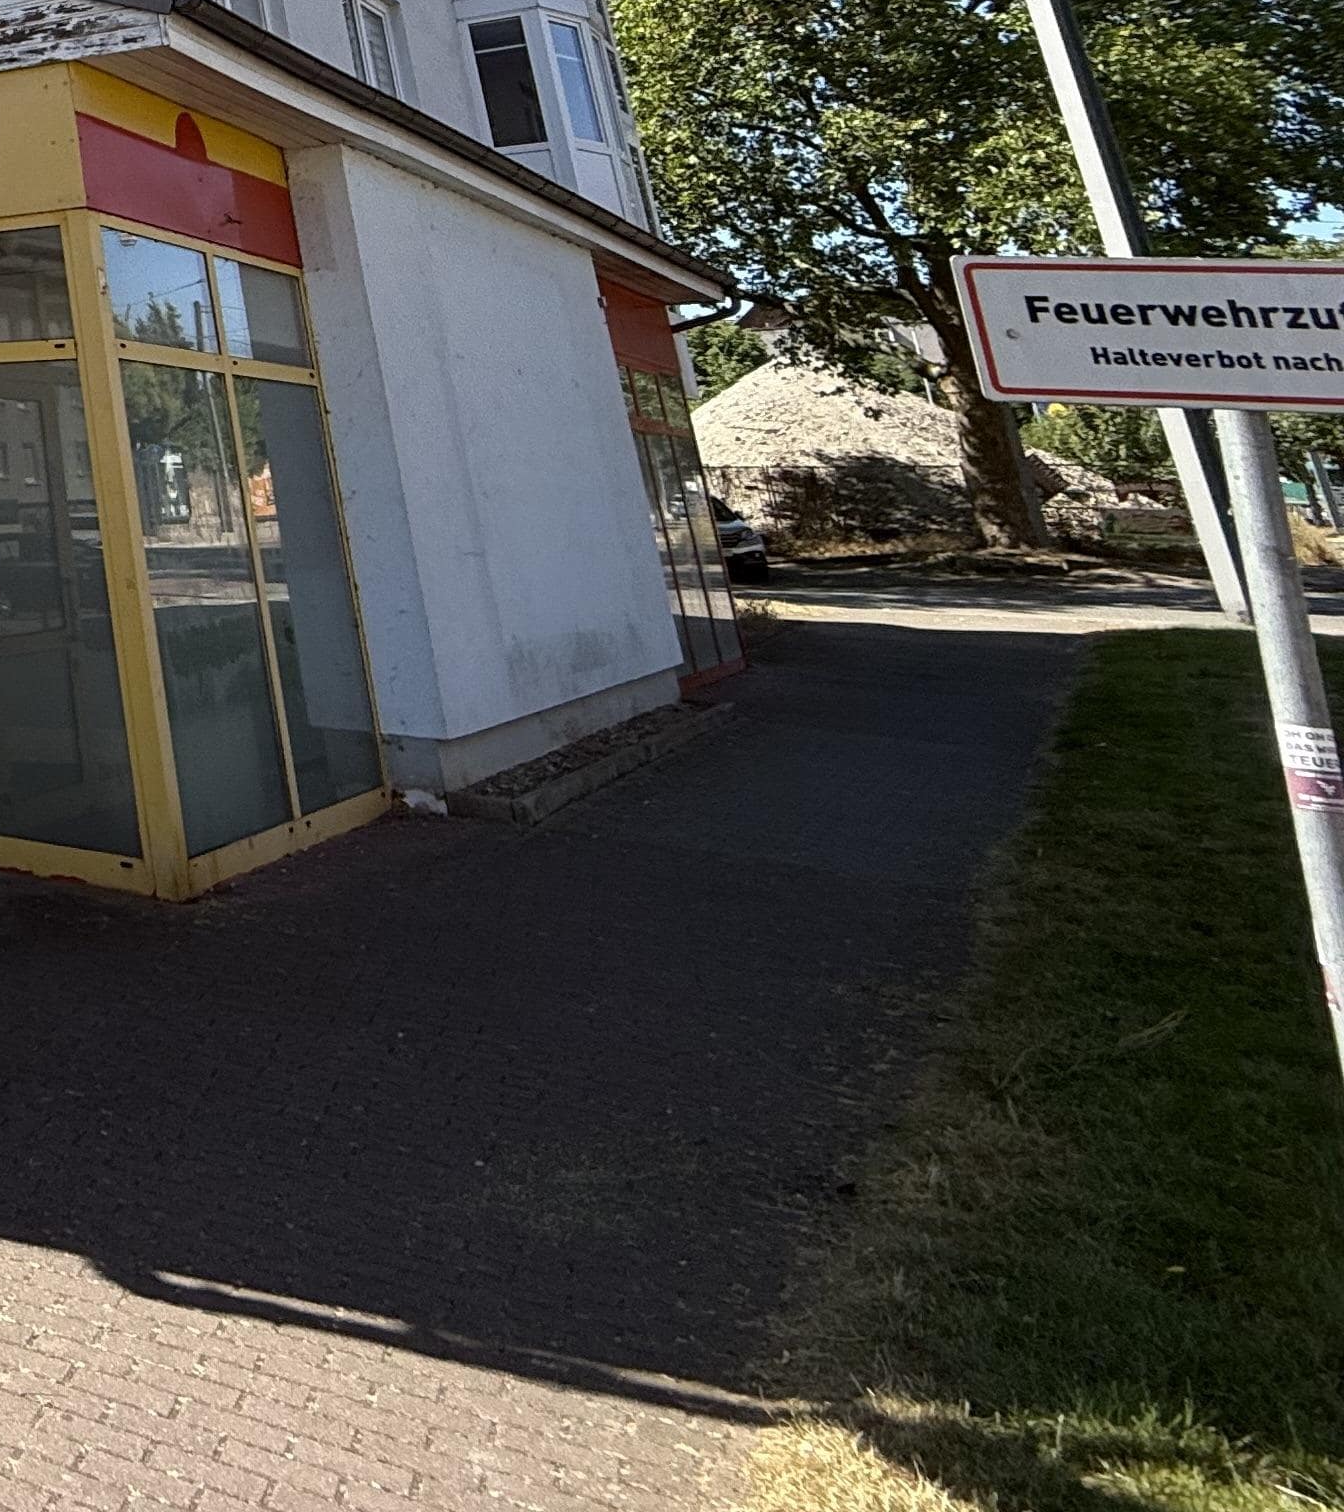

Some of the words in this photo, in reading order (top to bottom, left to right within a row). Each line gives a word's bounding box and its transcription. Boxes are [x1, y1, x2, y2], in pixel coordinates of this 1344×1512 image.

[1024, 295, 1344, 330] Feuerwehrzu
[1089, 346, 1267, 370] Halteverbot
[1273, 349, 1344, 373] nach
